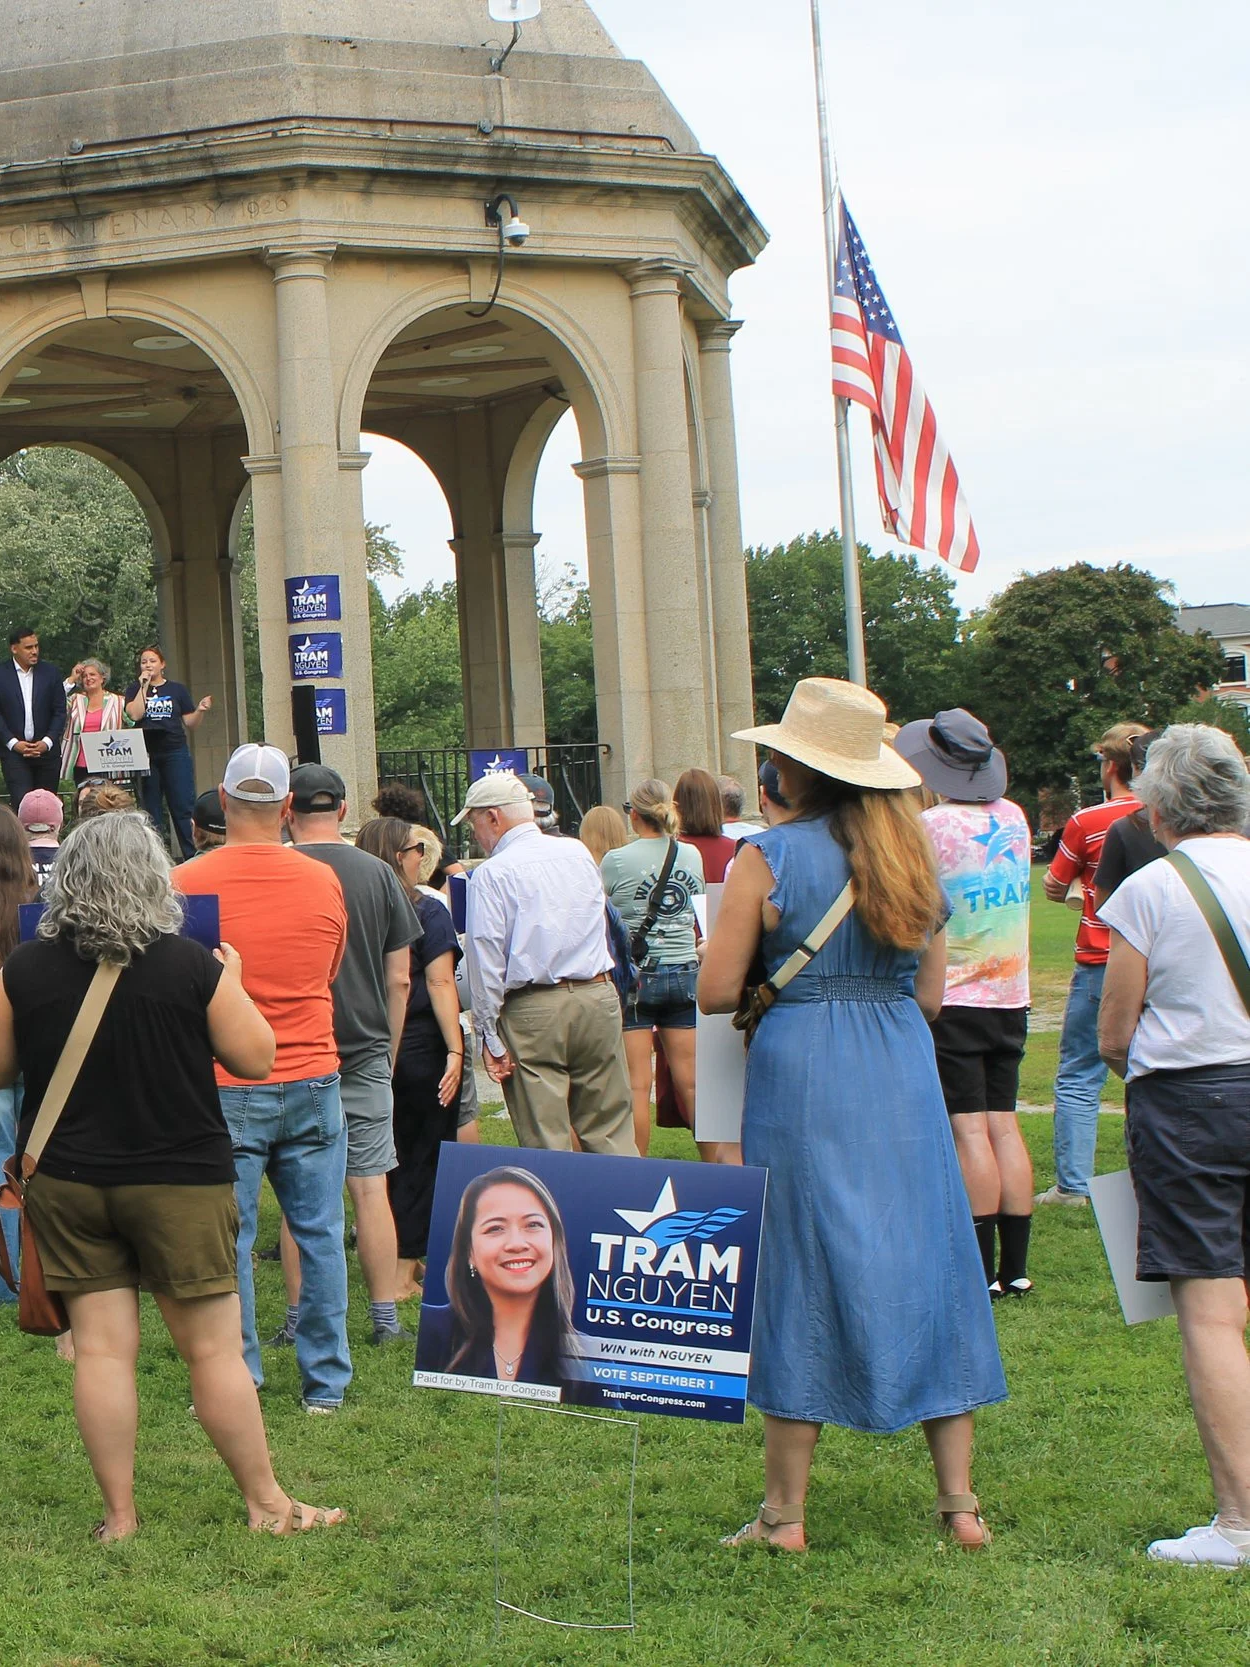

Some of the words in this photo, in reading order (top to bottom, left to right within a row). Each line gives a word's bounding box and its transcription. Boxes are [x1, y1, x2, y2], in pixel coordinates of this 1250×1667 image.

[238, 196, 290, 219] 1926
[292, 594, 326, 605] TRAM
[292, 604, 326, 613] NGUYEN
[294, 651, 328, 662] TRAM
[295, 661, 328, 670] NGUYEN
[316, 707, 332, 718] AM
[98, 747, 132, 757] TRAM
[590, 1232, 741, 1284] TRAM
[587, 1273, 736, 1312] NGUYEN
[585, 1308, 625, 1326] U.S.
[631, 1313, 733, 1337] Congress
[600, 1343, 626, 1355] WIN
[630, 1346, 655, 1358] with
[658, 1349, 712, 1364] NGUYEN
[416, 1373, 438, 1384] Paid
[440, 1374, 453, 1386] for
[455, 1377, 467, 1389] by
[470, 1379, 493, 1391] Tram
[495, 1382, 509, 1392] for
[511, 1384, 557, 1399] Congress
[593, 1367, 627, 1381] VOTE
[630, 1370, 705, 1389] SEPTEMBER
[708, 1379, 715, 1390] 1
[602, 1389, 706, 1409] TramForCongress.com
